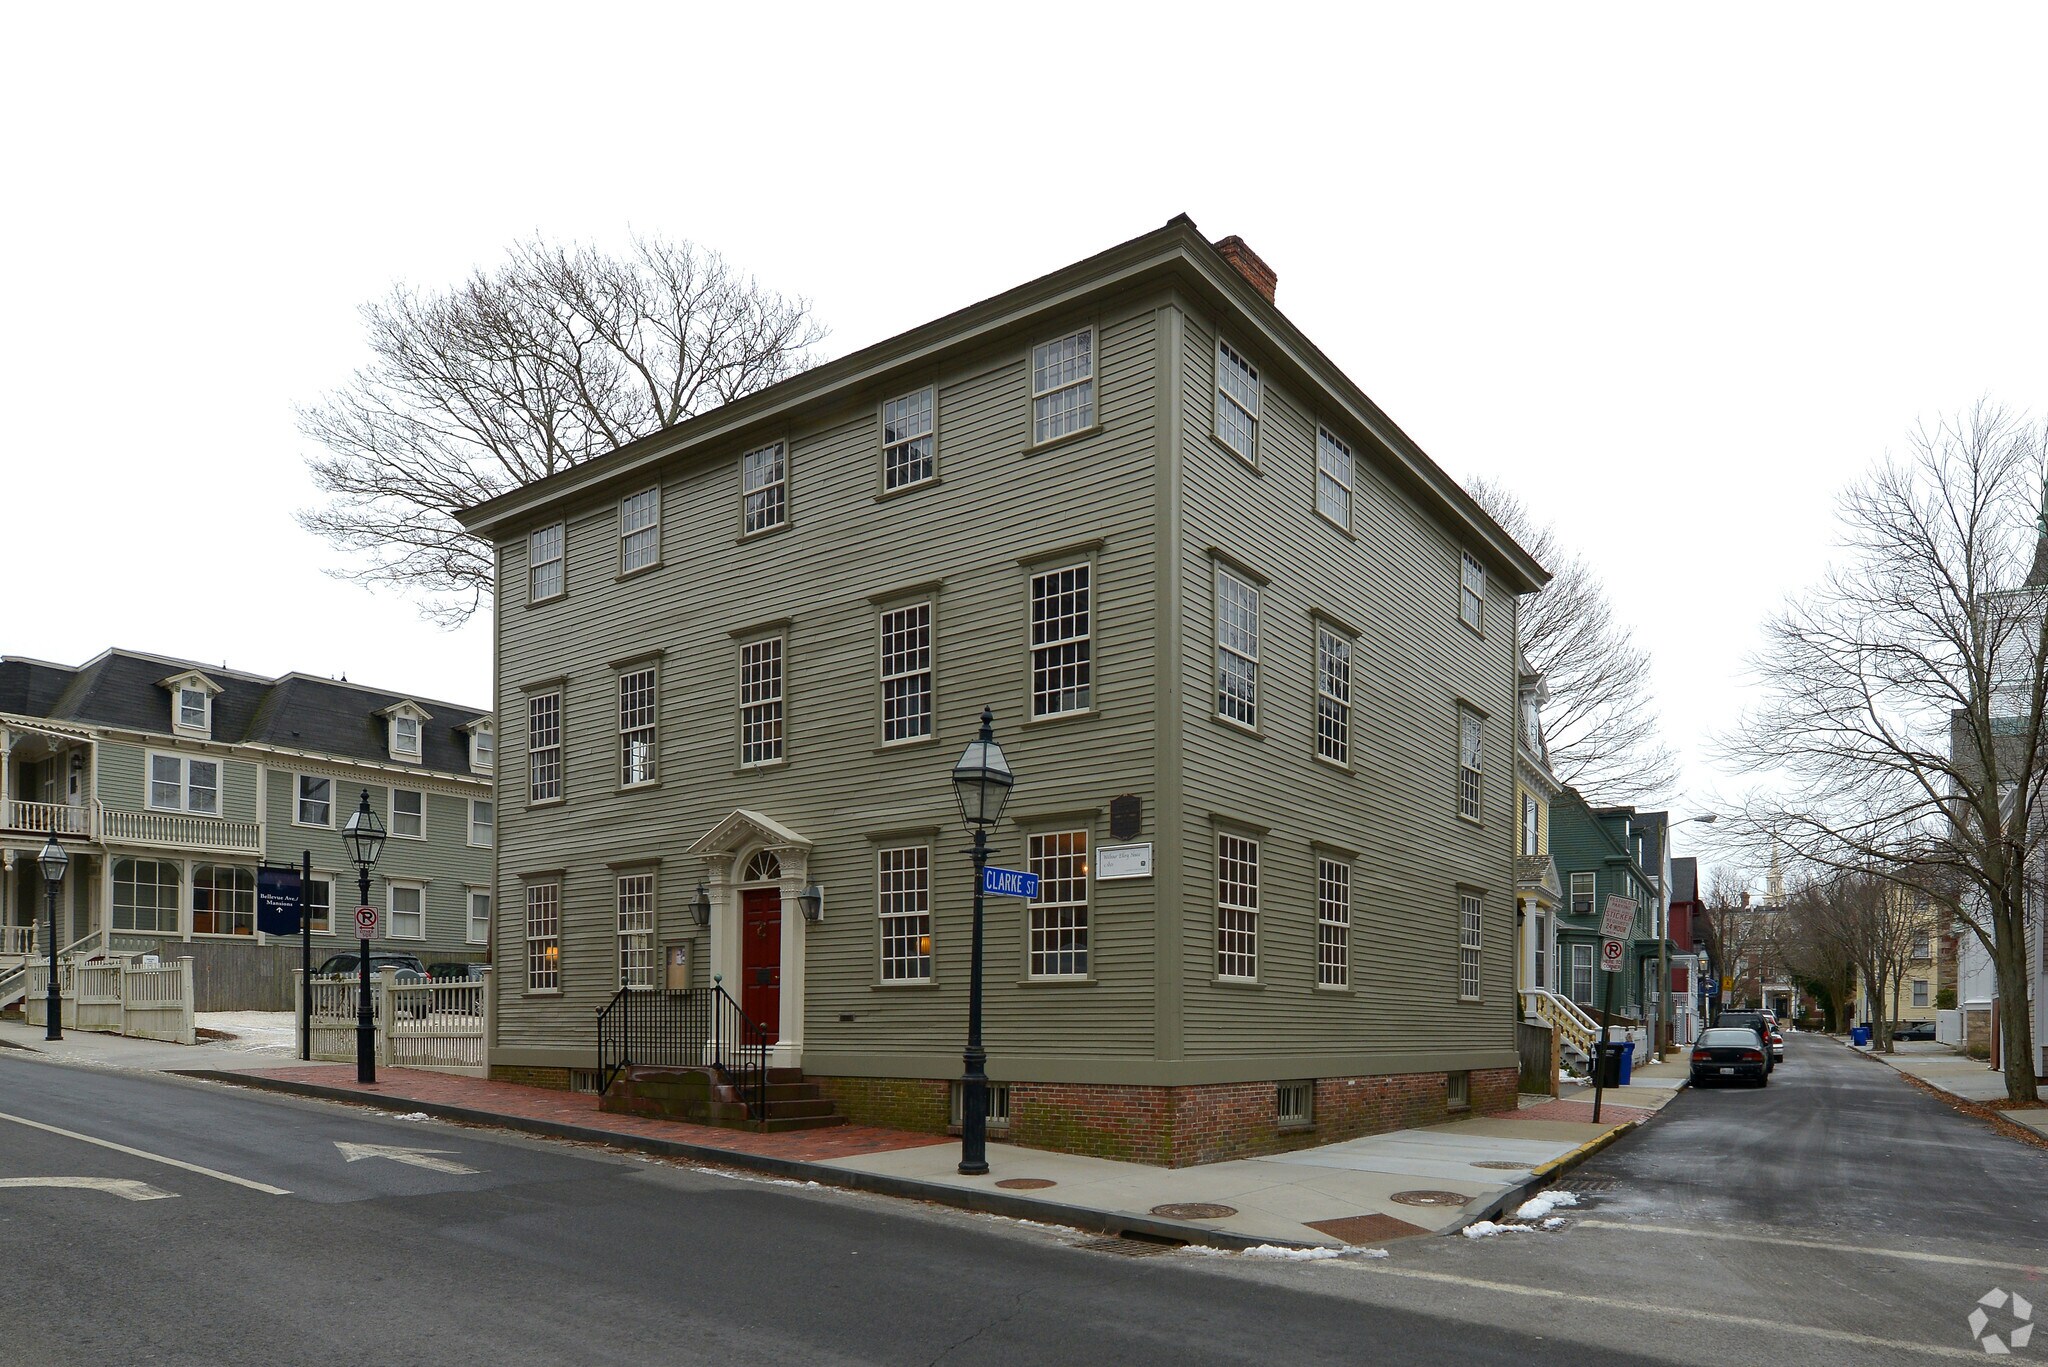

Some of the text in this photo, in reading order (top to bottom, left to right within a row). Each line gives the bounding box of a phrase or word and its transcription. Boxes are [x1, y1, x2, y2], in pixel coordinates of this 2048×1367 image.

[986, 870, 1035, 895] CLARKE ST
[260, 893, 284, 901] Bellevue
[266, 899, 293, 907] Mansions
[1605, 910, 1633, 922] STICKER
